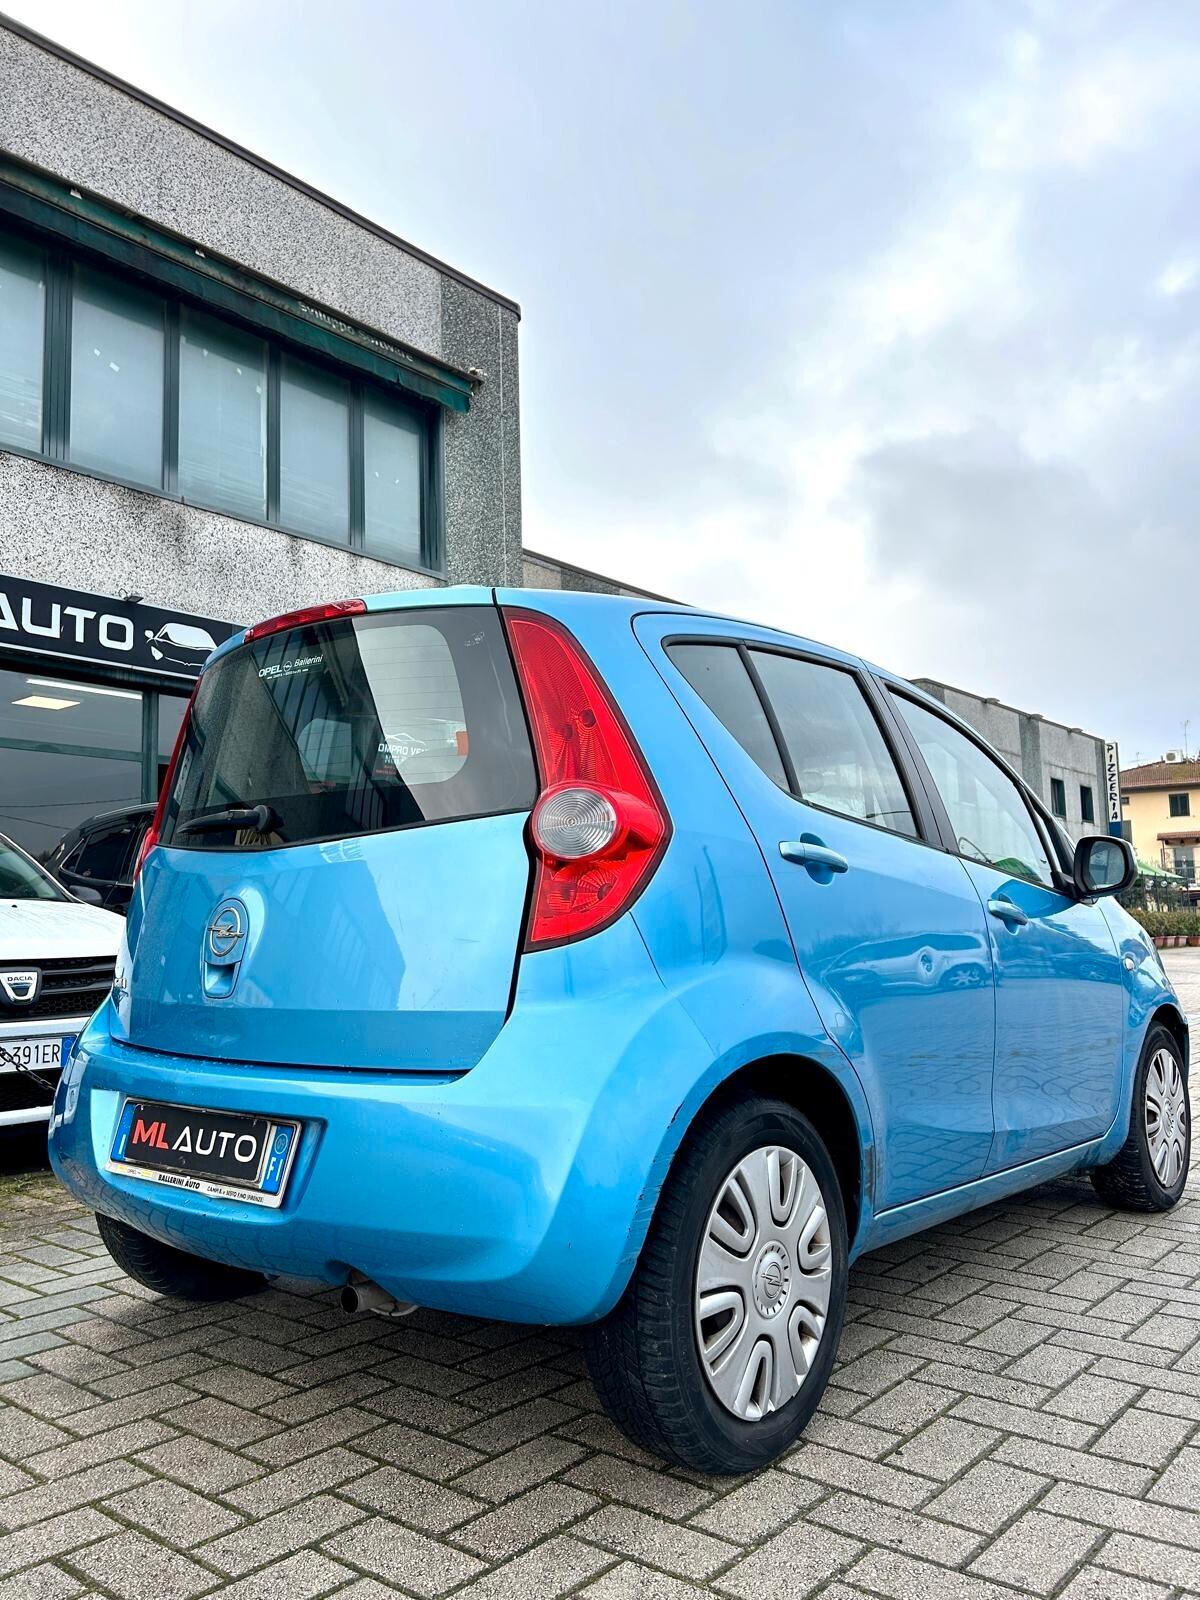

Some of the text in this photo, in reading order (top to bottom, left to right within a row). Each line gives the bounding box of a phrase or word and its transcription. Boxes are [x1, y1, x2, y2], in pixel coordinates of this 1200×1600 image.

[258, 664, 282, 678] OPEL
[294, 654, 324, 668] Ballerini
[378, 743, 409, 756] OMPRO
[1106, 744, 1119, 820] PIZZERIA
[131, 1118, 258, 1163] ML AUTO
[266, 1156, 284, 1182] FI
[157, 1174, 201, 1190] BALLERINI AUTO
